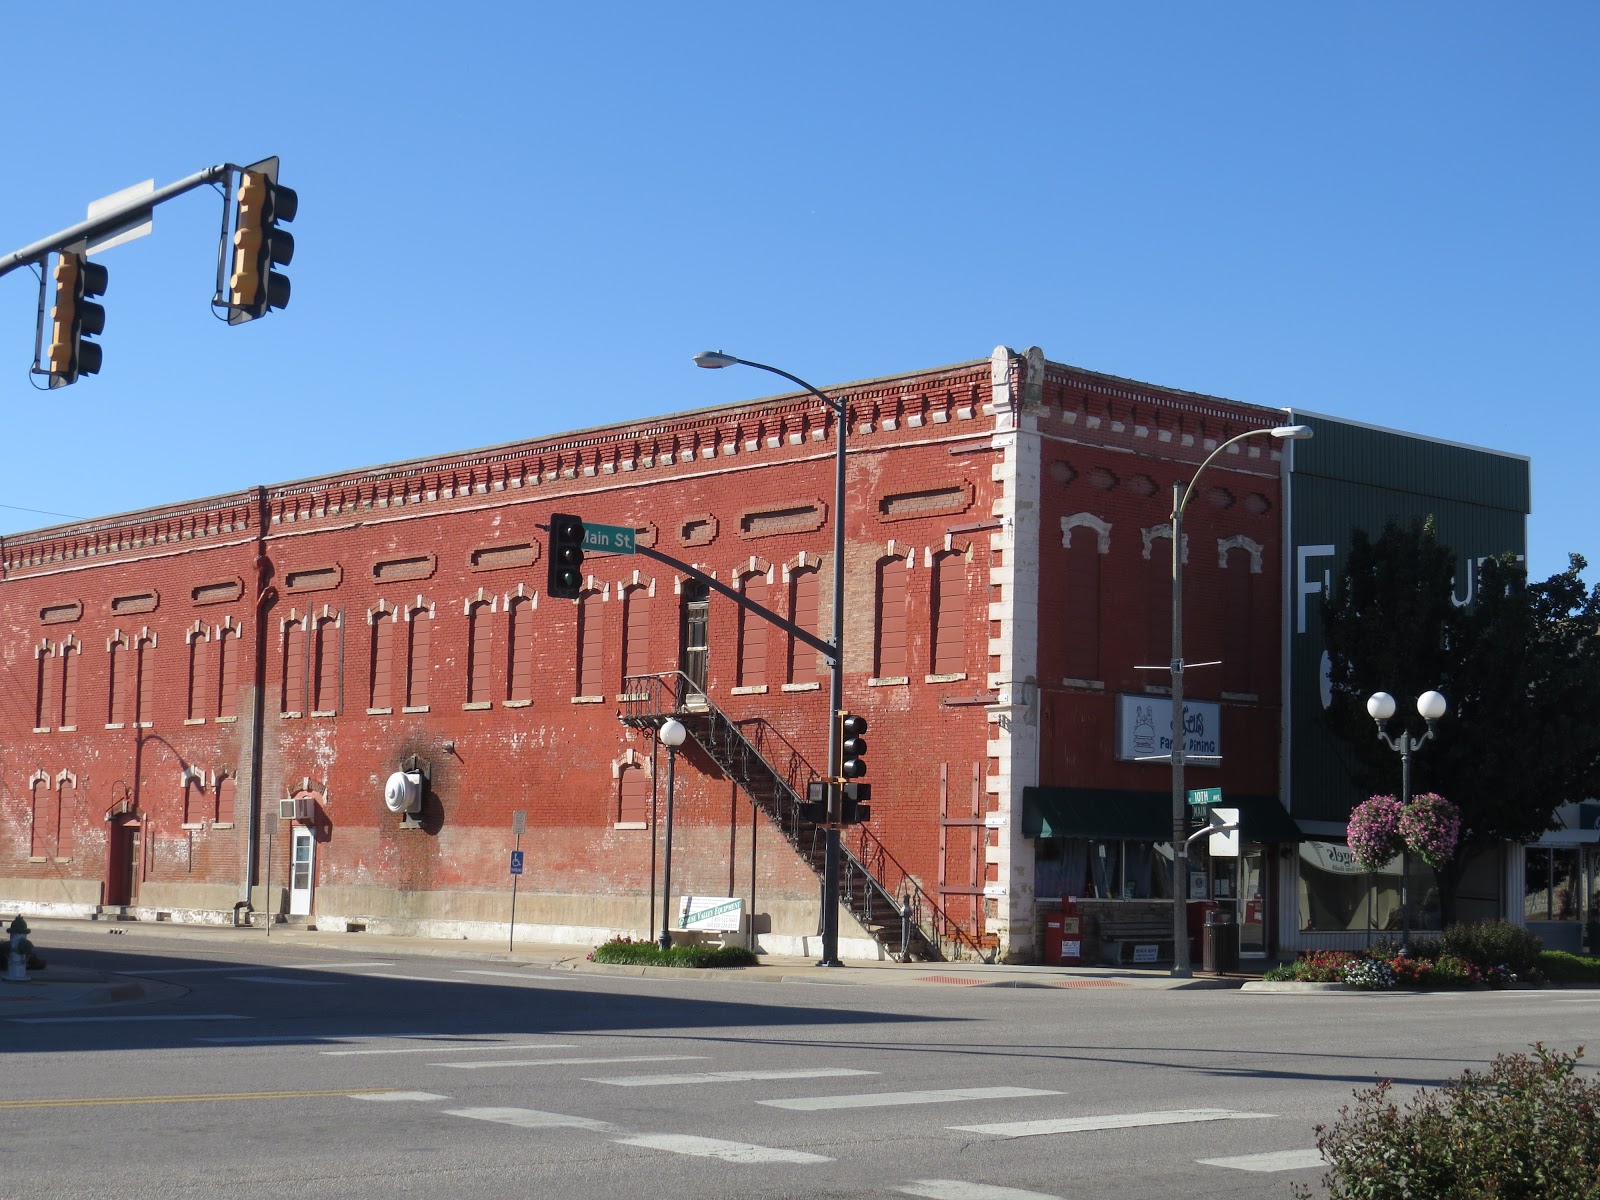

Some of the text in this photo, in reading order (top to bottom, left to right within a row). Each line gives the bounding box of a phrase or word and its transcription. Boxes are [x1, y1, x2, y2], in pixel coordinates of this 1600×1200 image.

[615, 533, 632, 549] St.
[1194, 791, 1208, 802] 10TH
[1193, 805, 1207, 817] MAIN
[714, 901, 741, 915] EQUIPMENT
